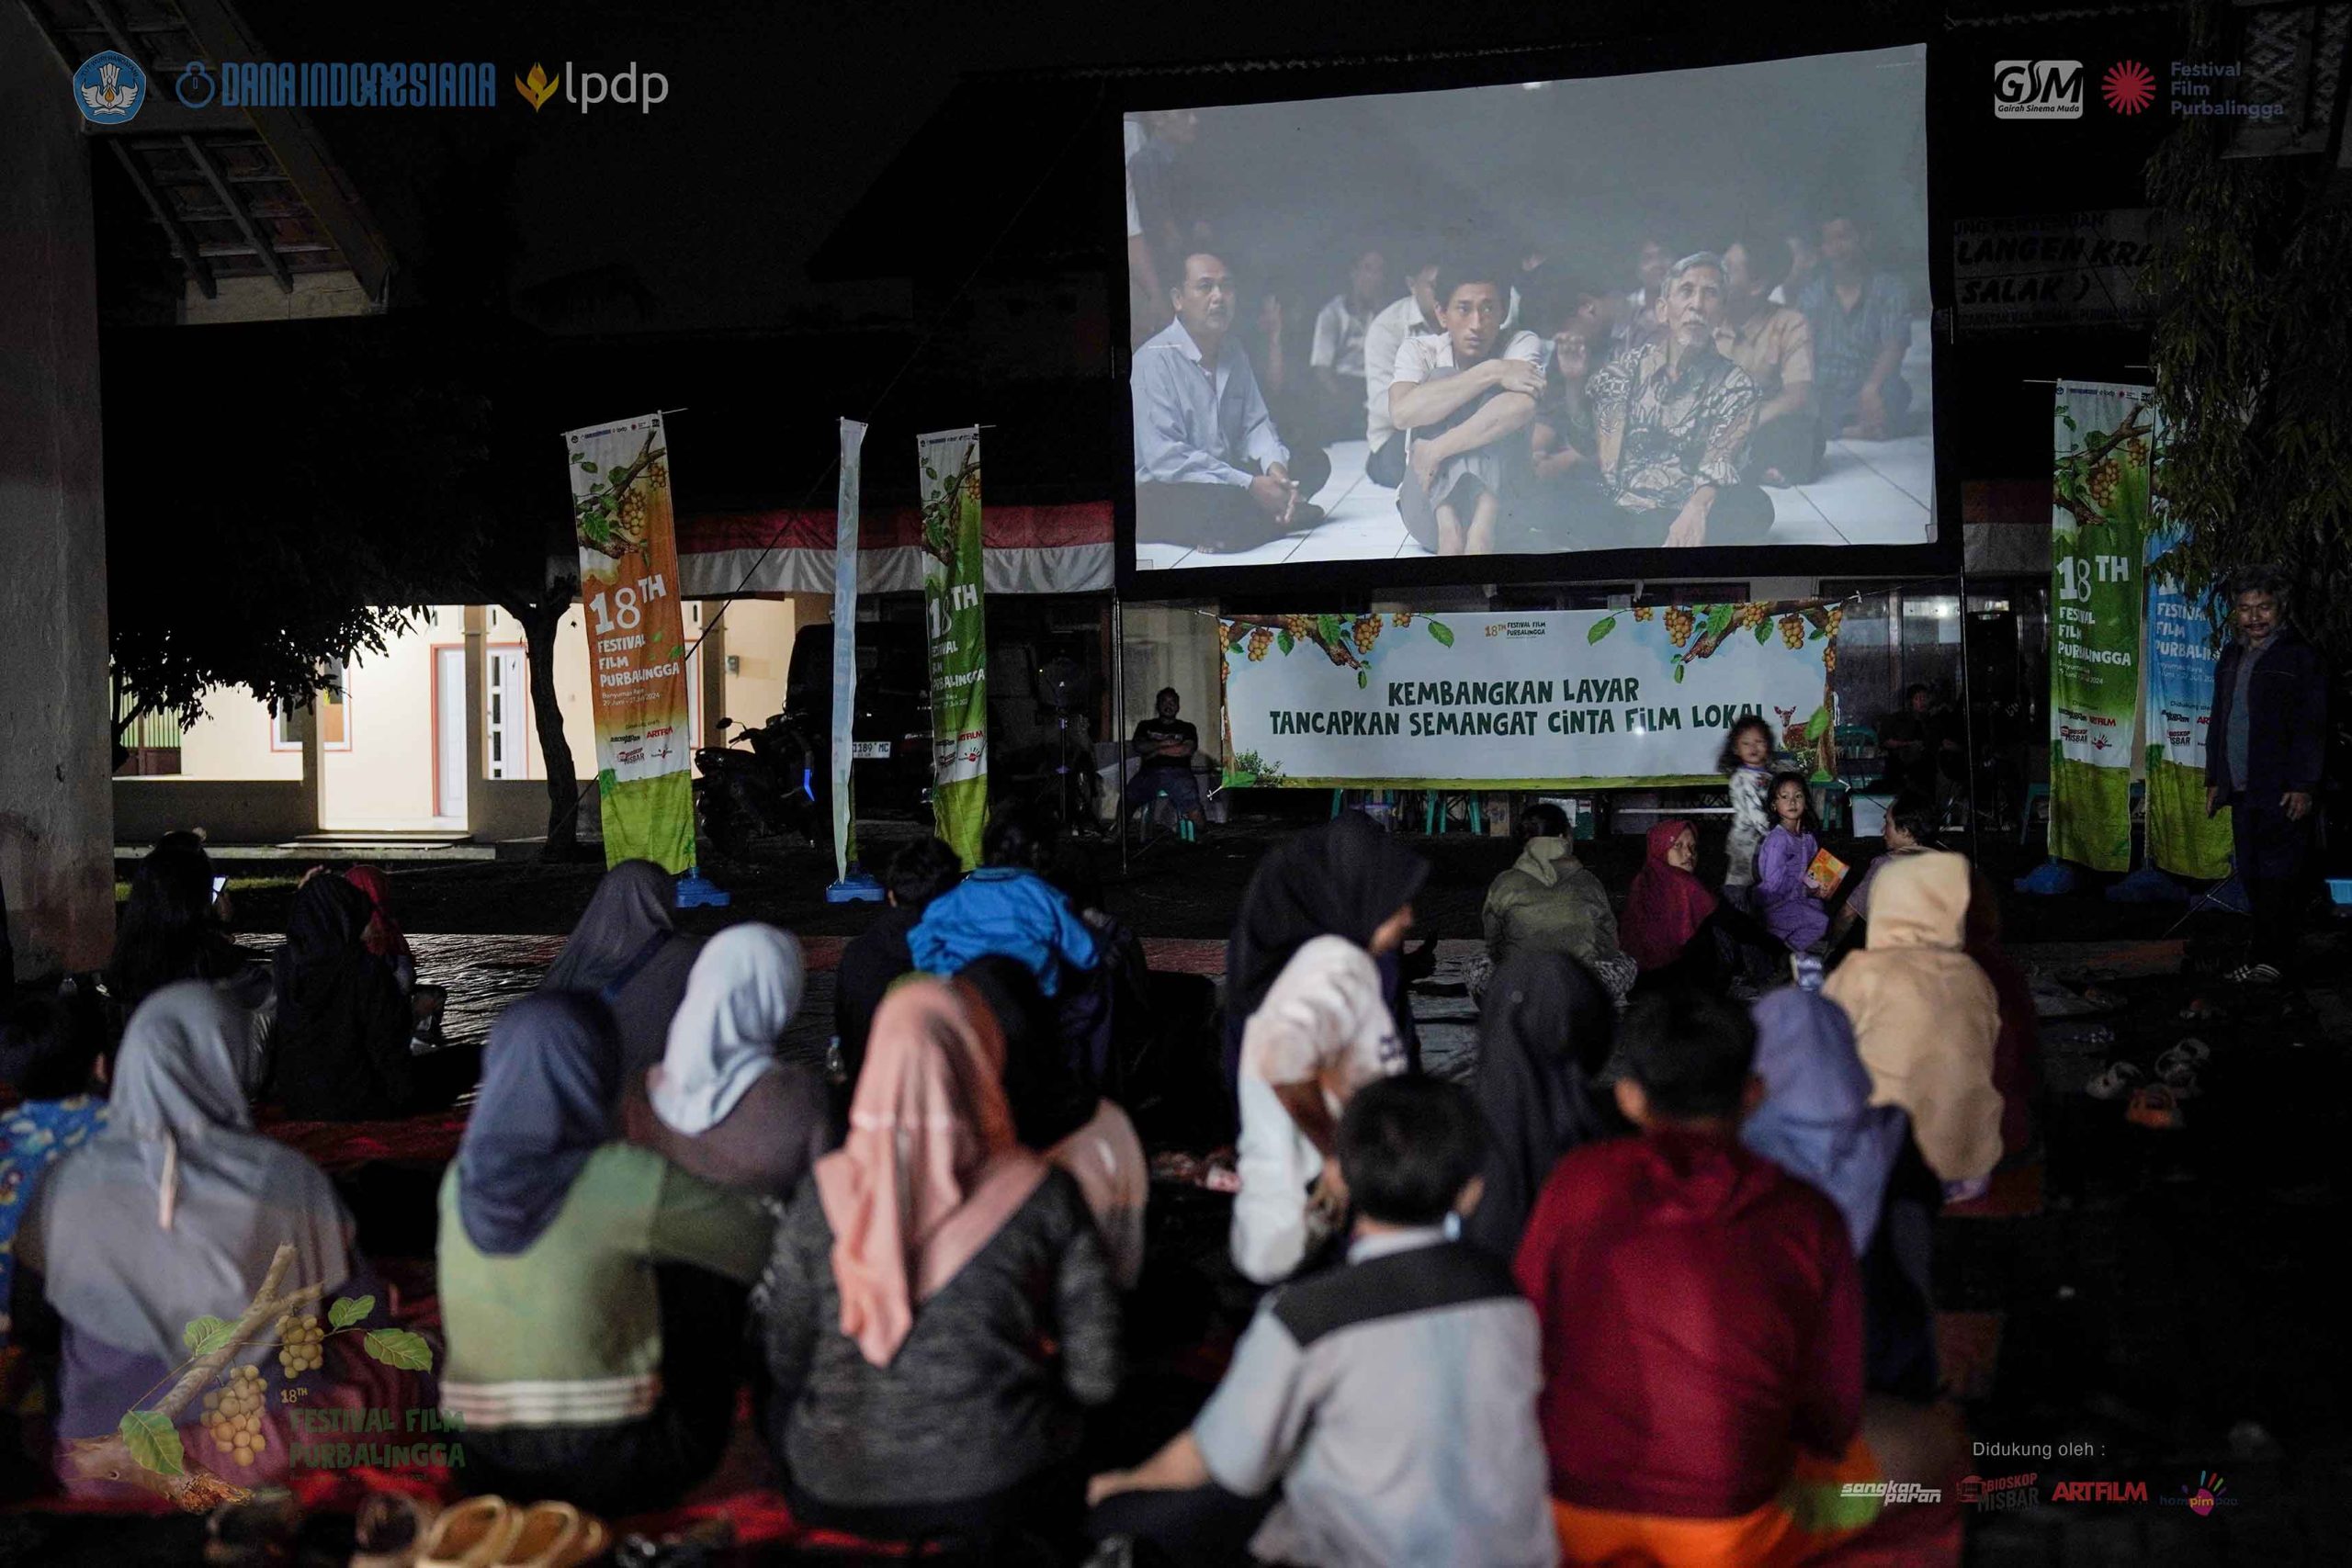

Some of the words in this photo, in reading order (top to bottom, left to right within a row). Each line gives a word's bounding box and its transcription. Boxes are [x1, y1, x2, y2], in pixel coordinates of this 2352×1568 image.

[1962, 276, 2064, 305] SALAK
[2156, 603, 2206, 622] FESTIVA
[2156, 622, 2185, 638] FILM
[597, 634, 646, 654] FESTIVAL
[599, 656, 629, 671] FILM
[600, 661, 680, 688] PURBALINGGA
[1388, 681, 1553, 706] KEMBANGKAN
[1563, 677, 1640, 703] LAYAR
[1270, 710, 1400, 736] TANCAPKAN
[1409, 711, 1538, 737] SEMANGAT
[878, 743, 889, 752] MC
